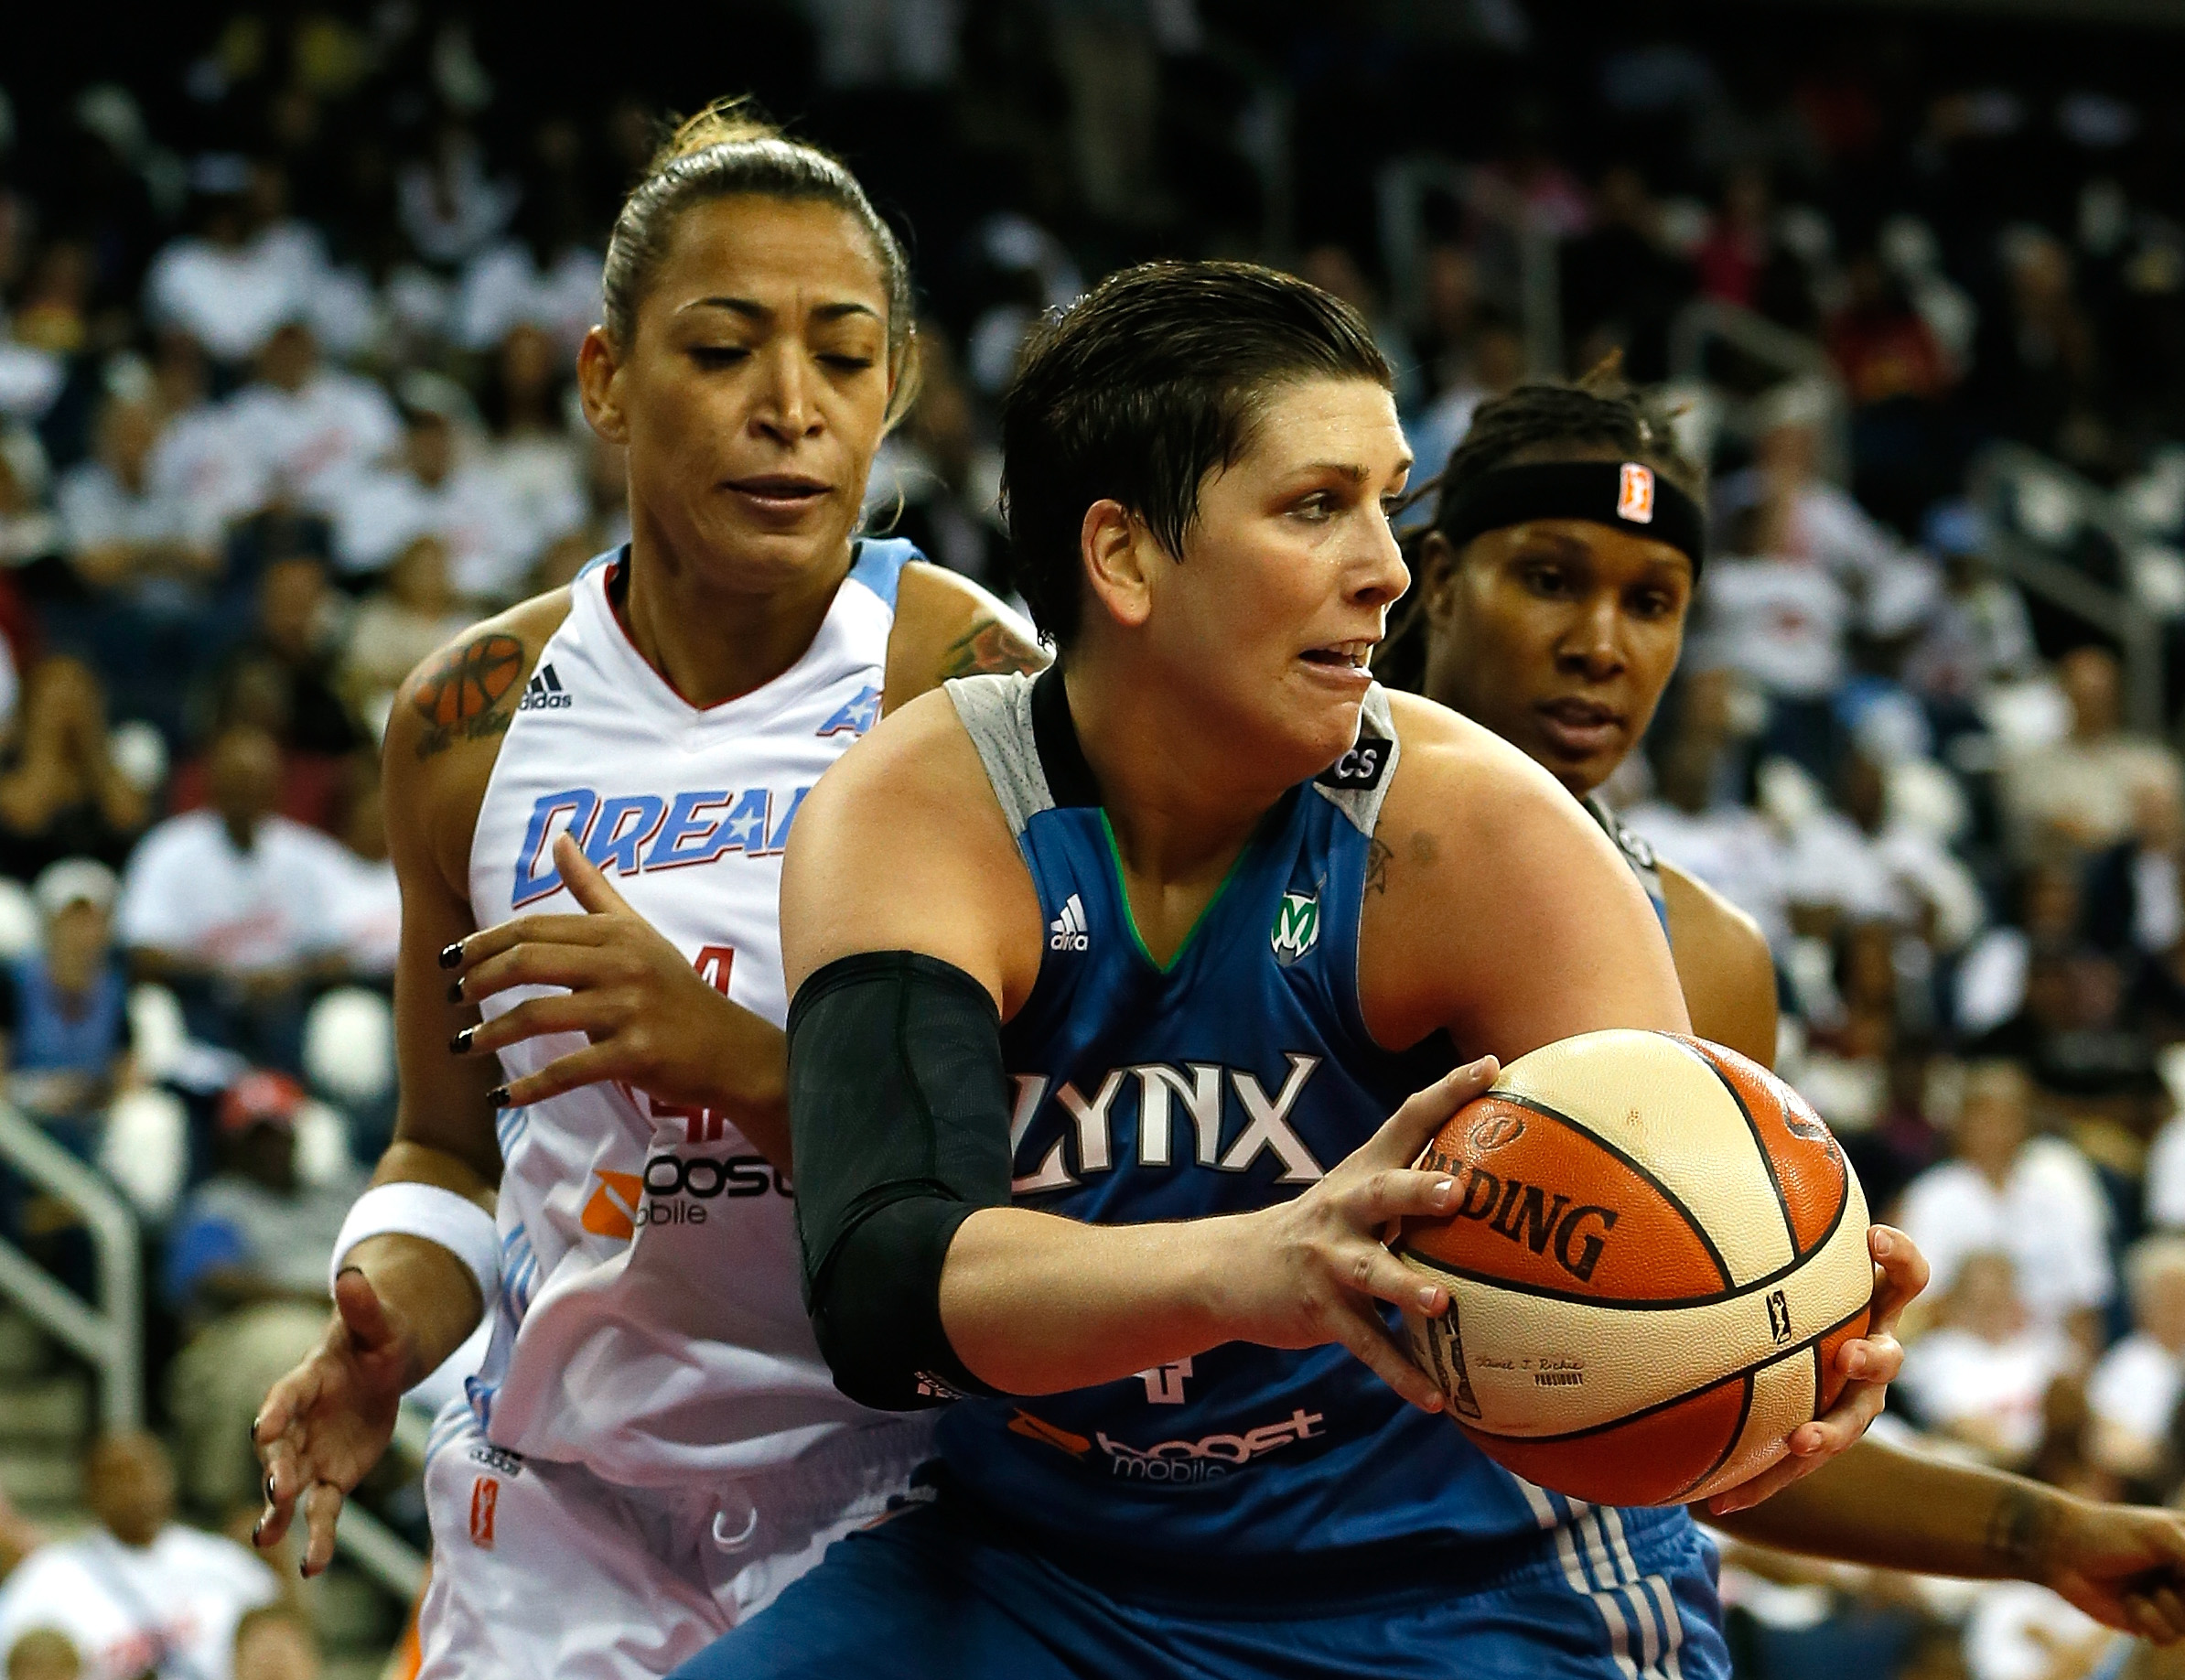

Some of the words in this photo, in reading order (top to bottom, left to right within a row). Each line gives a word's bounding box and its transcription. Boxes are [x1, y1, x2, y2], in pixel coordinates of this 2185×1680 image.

[1334, 748, 1377, 779] CS
[1006, 1051, 1324, 1197] LYNX
[635, 1199, 707, 1226] obile
[1421, 1147, 1619, 1283] DING
[1095, 1408, 1326, 1464] boost
[1113, 1454, 1228, 1483] mobile
